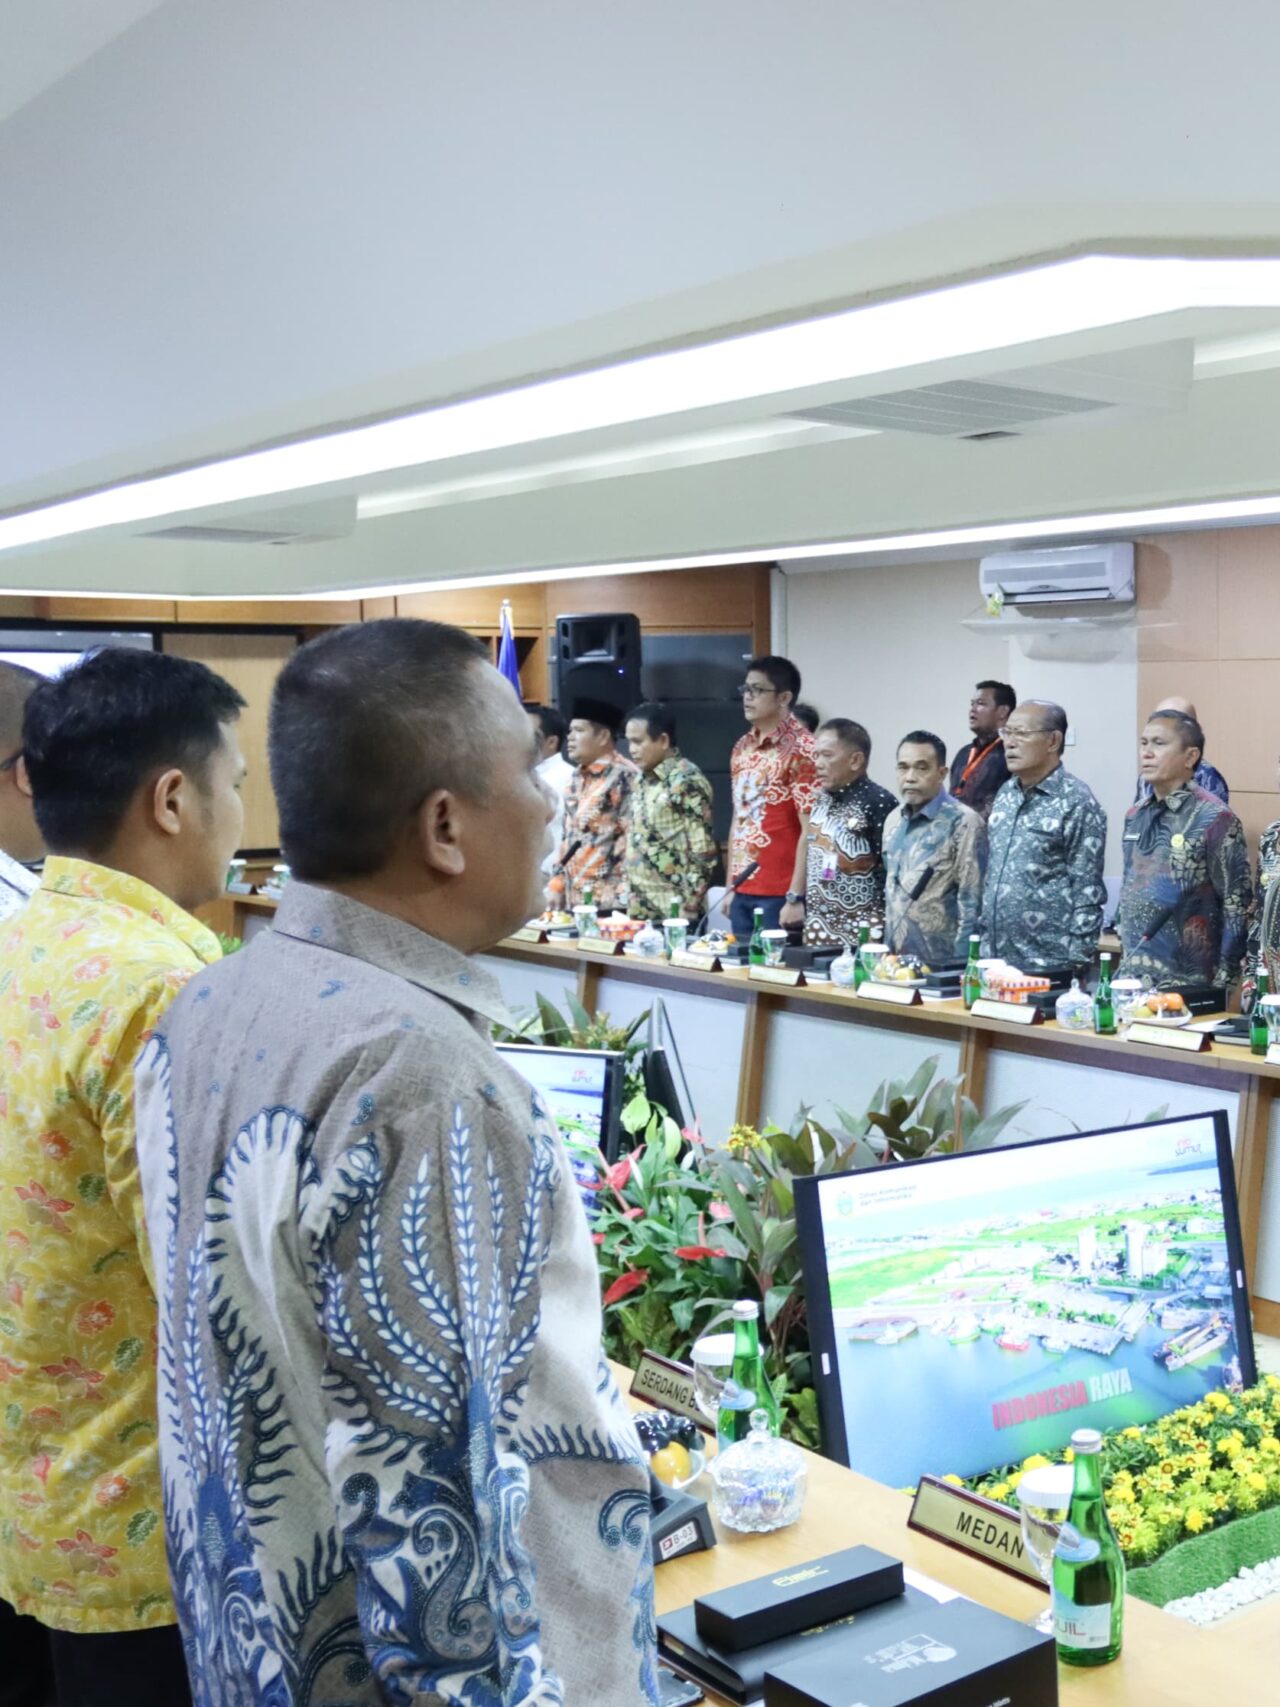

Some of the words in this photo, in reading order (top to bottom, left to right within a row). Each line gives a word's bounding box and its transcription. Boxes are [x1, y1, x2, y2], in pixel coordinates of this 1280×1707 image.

[641, 1369, 689, 1404] SERDANG
[992, 1380, 1088, 1431] INDONESIA
[1089, 1367, 1133, 1402] RAYA
[673, 1525, 695, 1544] B-03
[956, 1511, 1025, 1559] MEDAN
